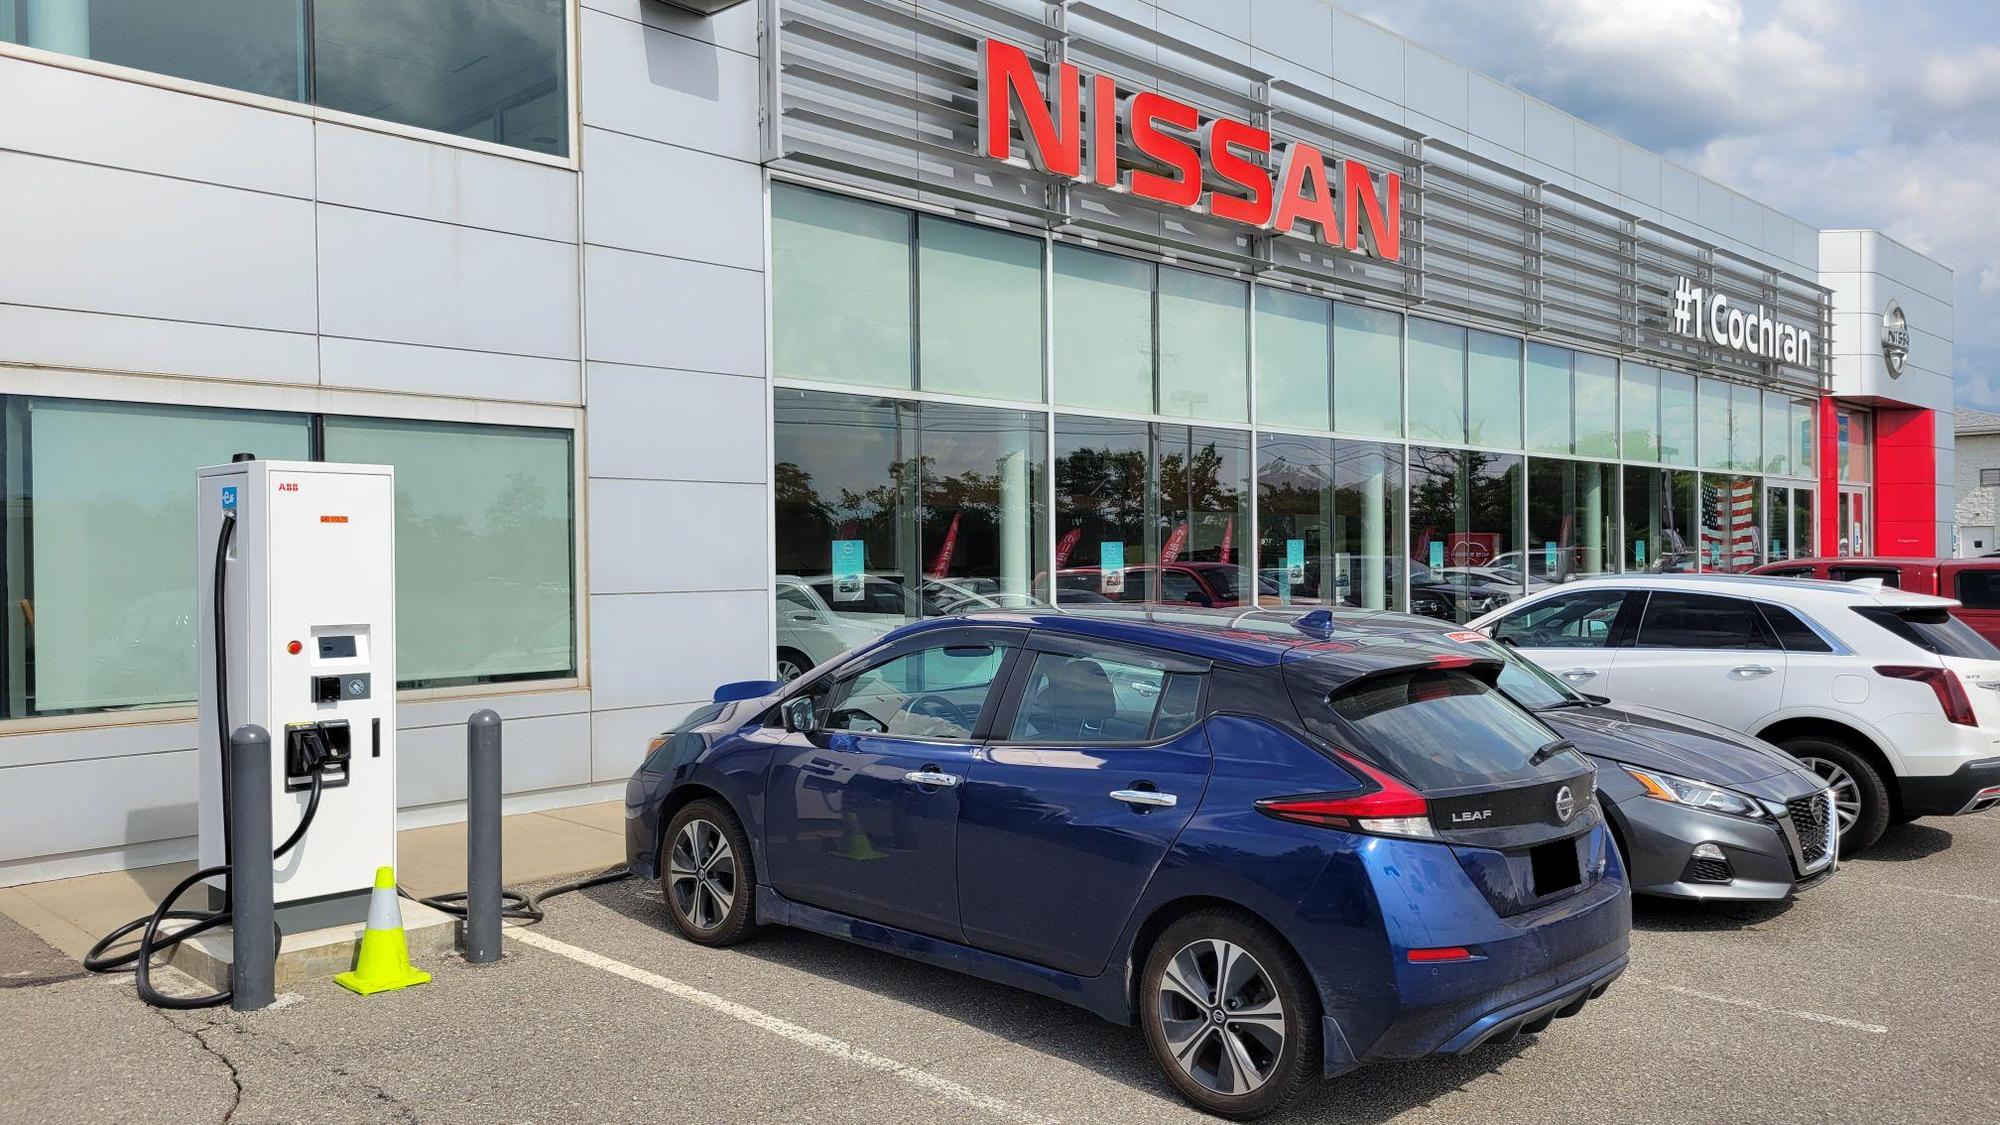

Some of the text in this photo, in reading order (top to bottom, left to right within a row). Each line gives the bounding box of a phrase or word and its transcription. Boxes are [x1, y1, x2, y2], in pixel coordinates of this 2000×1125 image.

[984, 38, 1400, 261] NISSAN
[1674, 276, 1811, 367] #1 Cochran
[279, 483, 299, 491] ABB
[1451, 810, 1492, 822] LEAF
